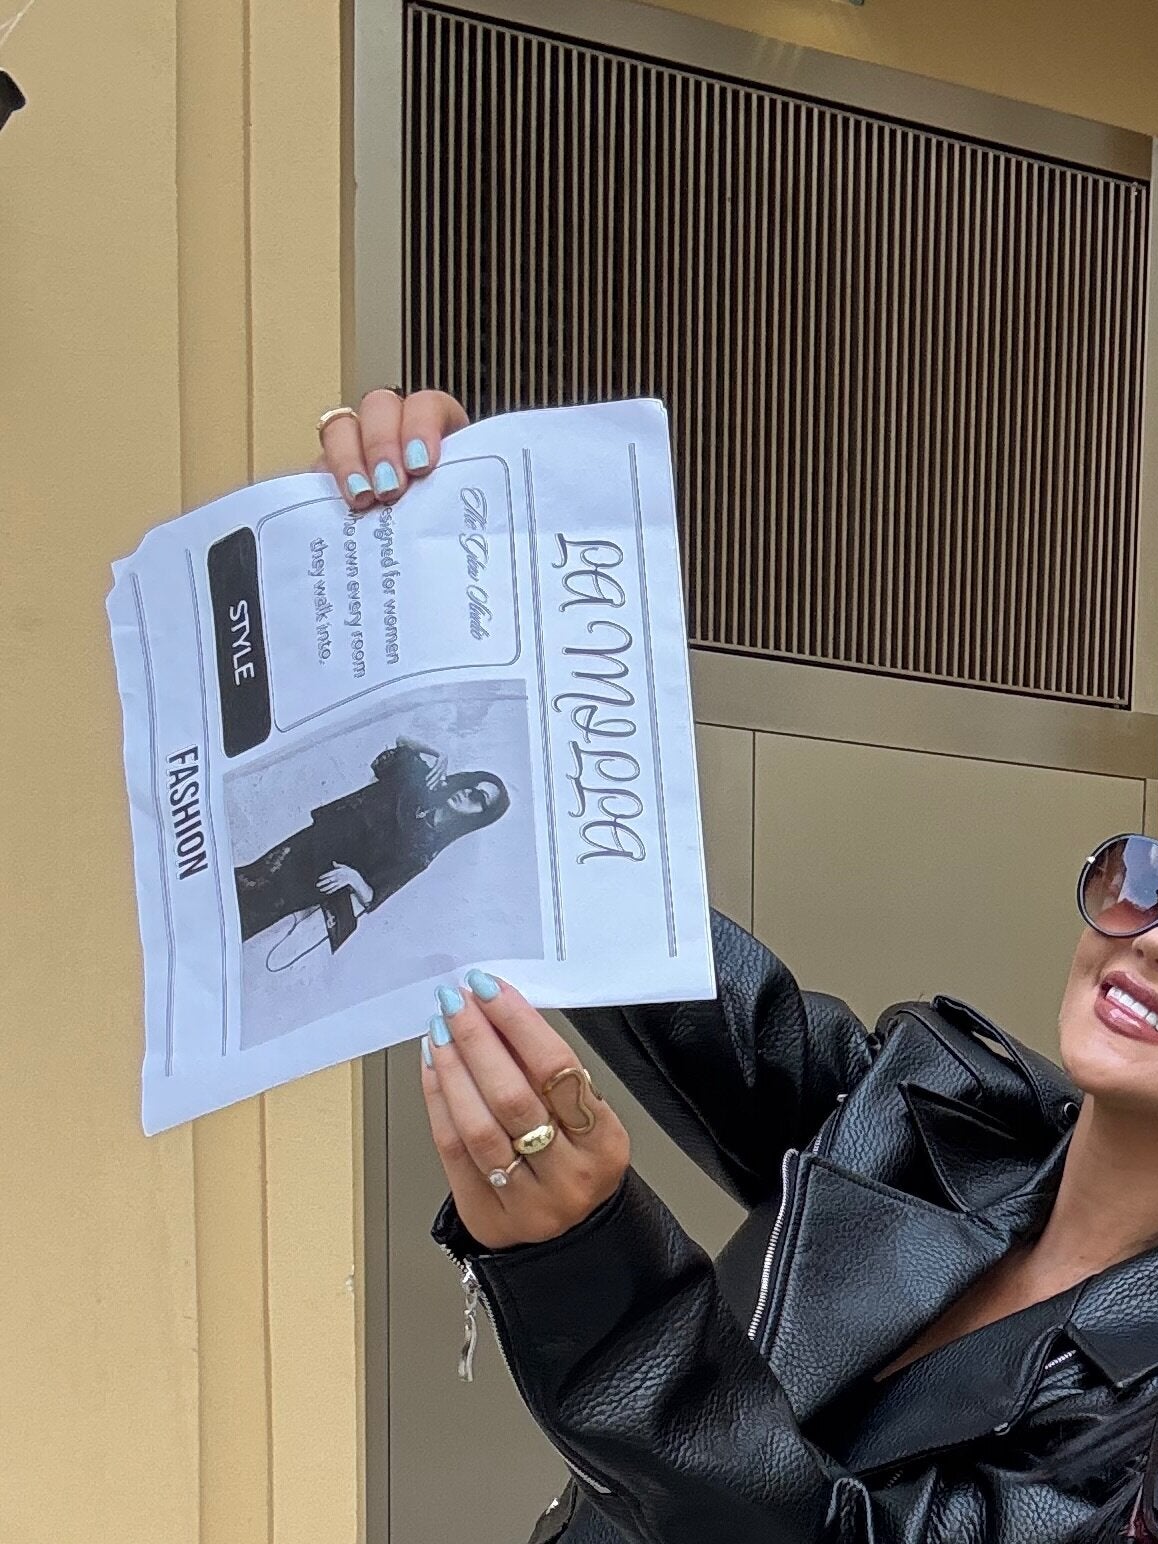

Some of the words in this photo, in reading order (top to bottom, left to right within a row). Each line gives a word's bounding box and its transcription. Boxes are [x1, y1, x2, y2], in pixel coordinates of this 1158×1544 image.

[459, 487, 488, 531] The
[307, 537, 328, 577] they
[344, 539, 359, 577] own
[373, 503, 400, 568] esigned
[458, 533, 489, 582] Glow
[382, 571, 401, 595] for
[552, 533, 626, 613] LA
[313, 579, 333, 622] walk
[344, 580, 362, 627] every
[466, 584, 493, 640] Studio
[229, 599, 255, 686] STYLE
[316, 621, 332, 666] into.
[351, 630, 366, 679] room
[383, 599, 400, 665] women
[552, 620, 646, 864] MILLA
[166, 744, 209, 880] FASHION
